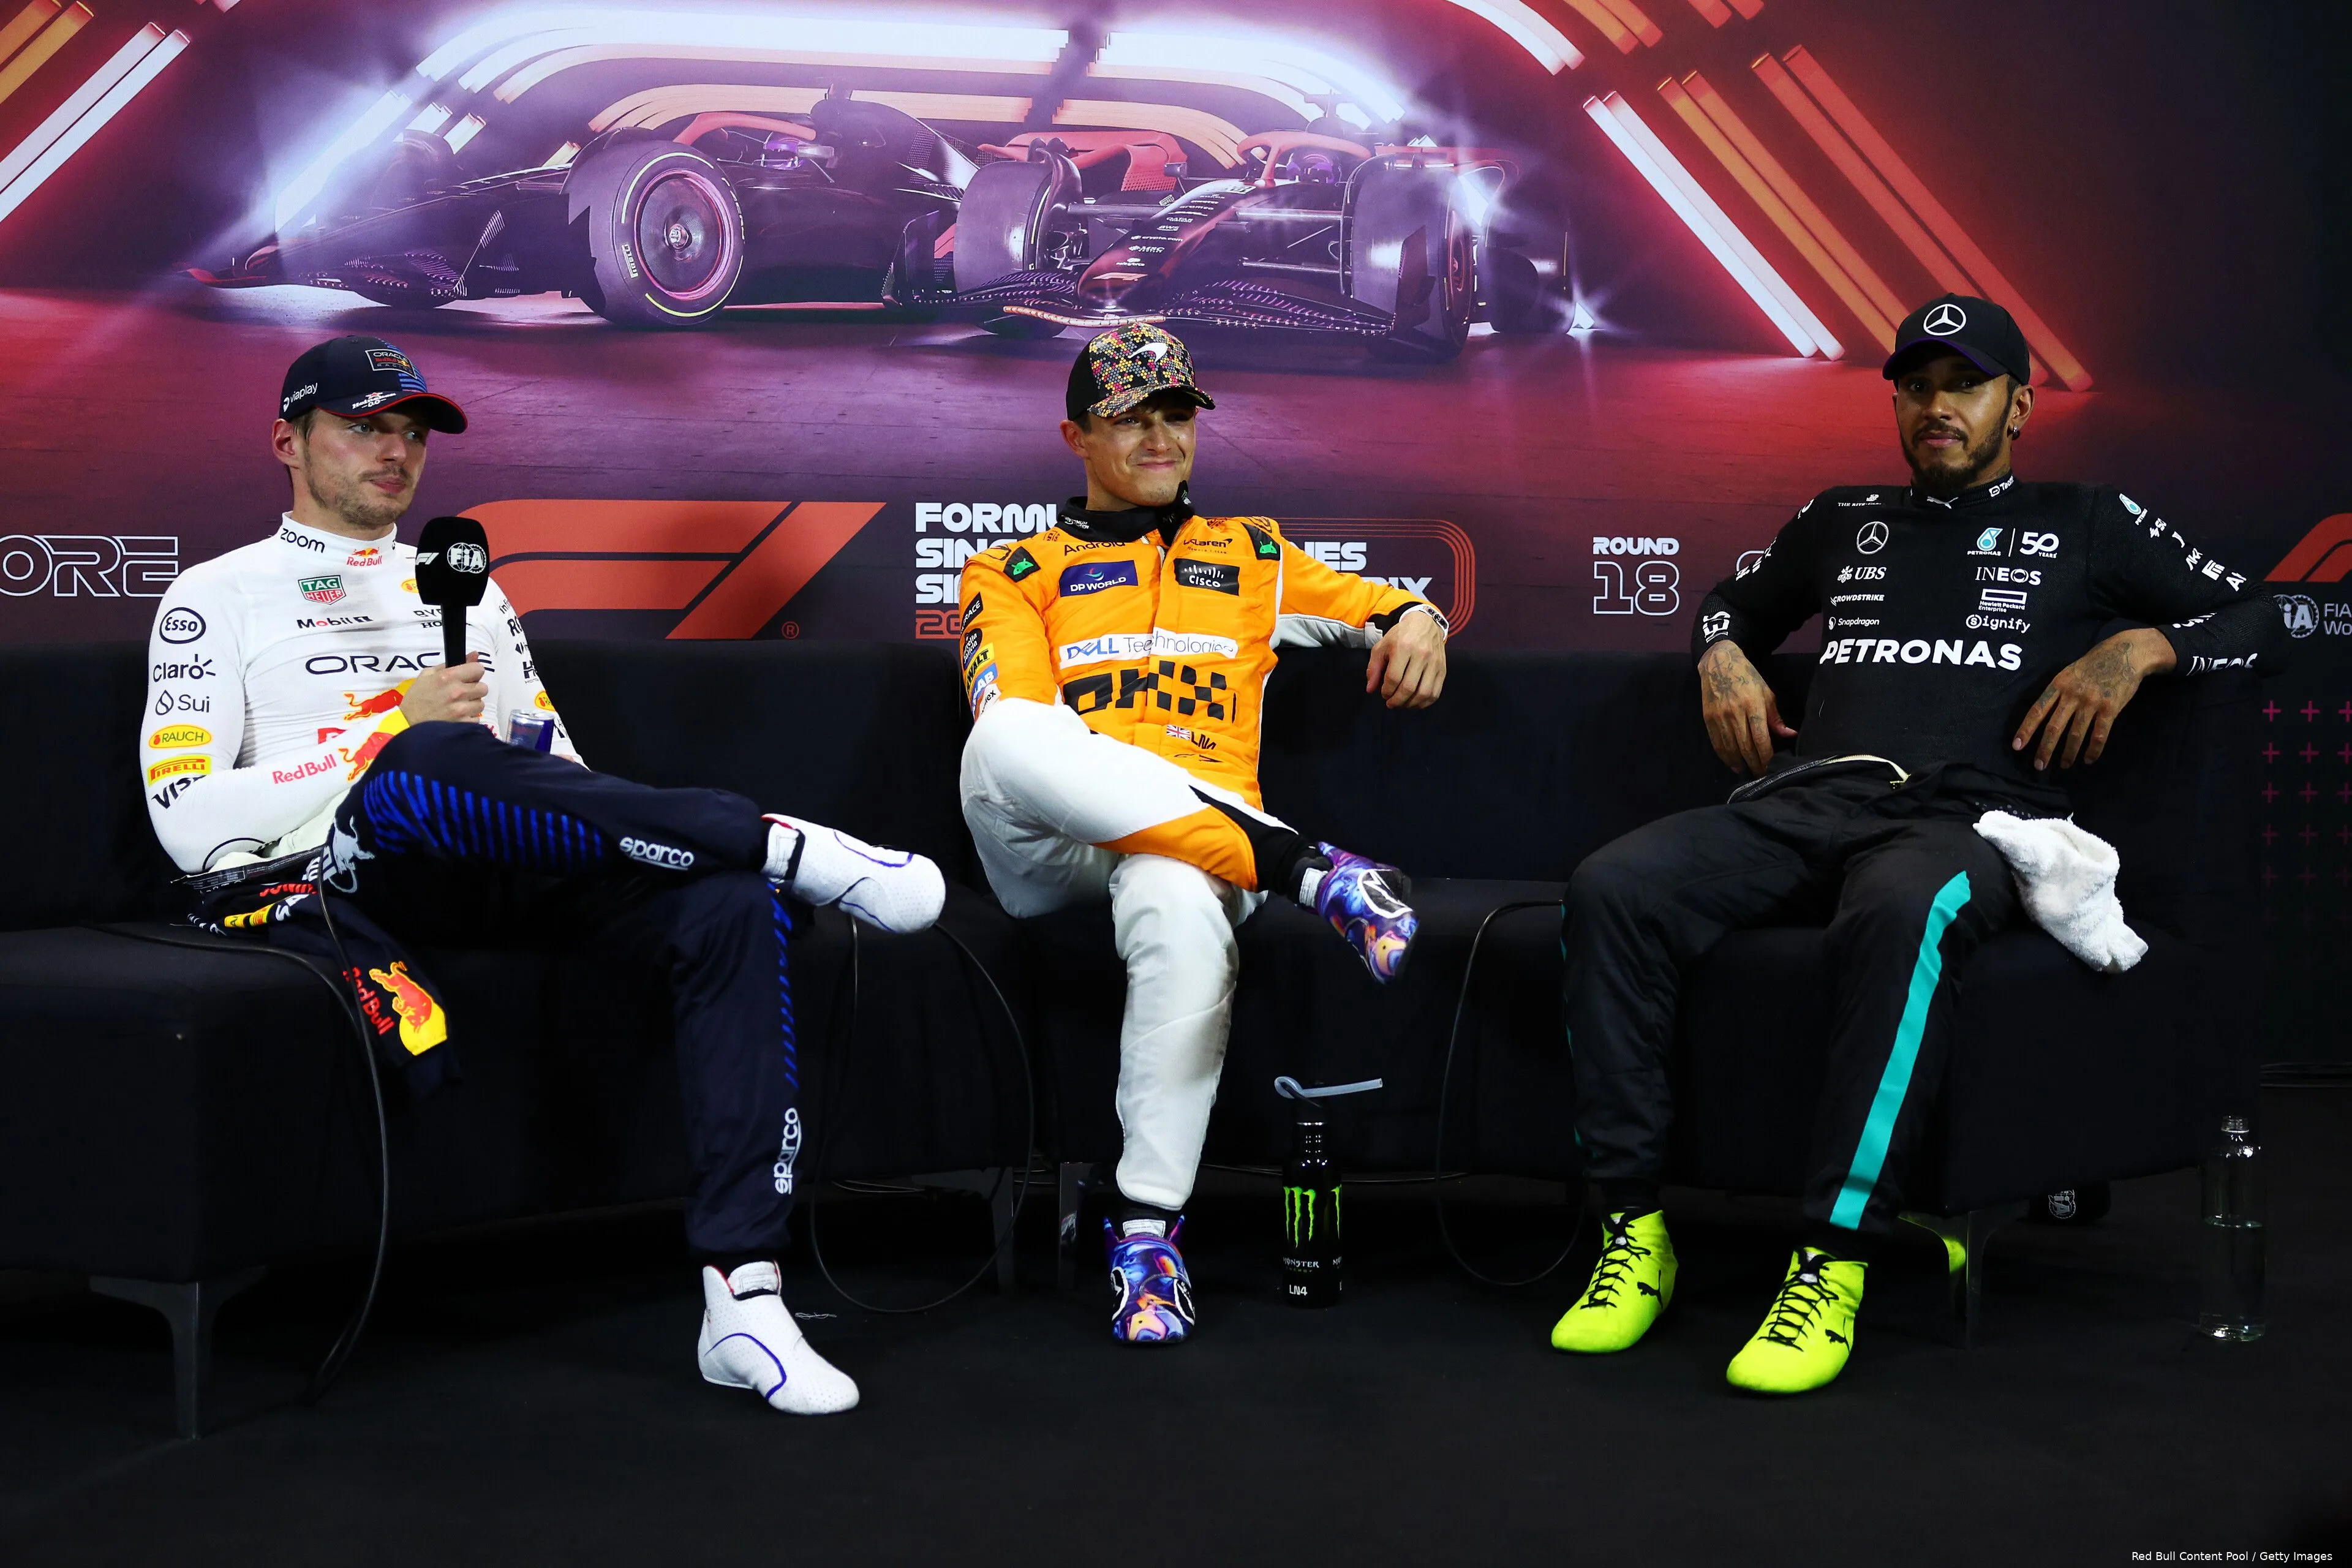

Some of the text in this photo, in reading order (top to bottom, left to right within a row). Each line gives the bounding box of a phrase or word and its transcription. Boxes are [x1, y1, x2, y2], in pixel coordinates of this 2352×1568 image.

[373, 352, 409, 363] ORACLE
[290, 382, 318, 404] viaplay
[280, 527, 325, 554] zoom
[1593, 537, 1680, 556] ROUND
[347, 555, 382, 567] Red Bull
[1854, 566, 1887, 581] UBS
[1975, 567, 2042, 586] INEOS
[303, 578, 338, 591] TAG
[1070, 576, 1126, 592] DP WORLD
[1593, 560, 1680, 616] 18
[305, 589, 342, 603] HEUER
[1832, 594, 1885, 604] CROWDSTRIKE
[2323, 603, 2352, 618] FIA
[164, 616, 198, 632] Esso
[296, 617, 353, 629] Mobil
[1838, 617, 1880, 627] Snapdragon
[1066, 637, 1120, 660] DELL
[1819, 638, 2022, 671] PETRONAS
[177, 694, 210, 713] Sui
[162, 731, 204, 743] RAUCH
[150, 758, 206, 782] PIRELLI
[619, 837, 695, 869] sparco
[773, 1107, 800, 1195] sparco
[1289, 1283, 1308, 1297] LN4
